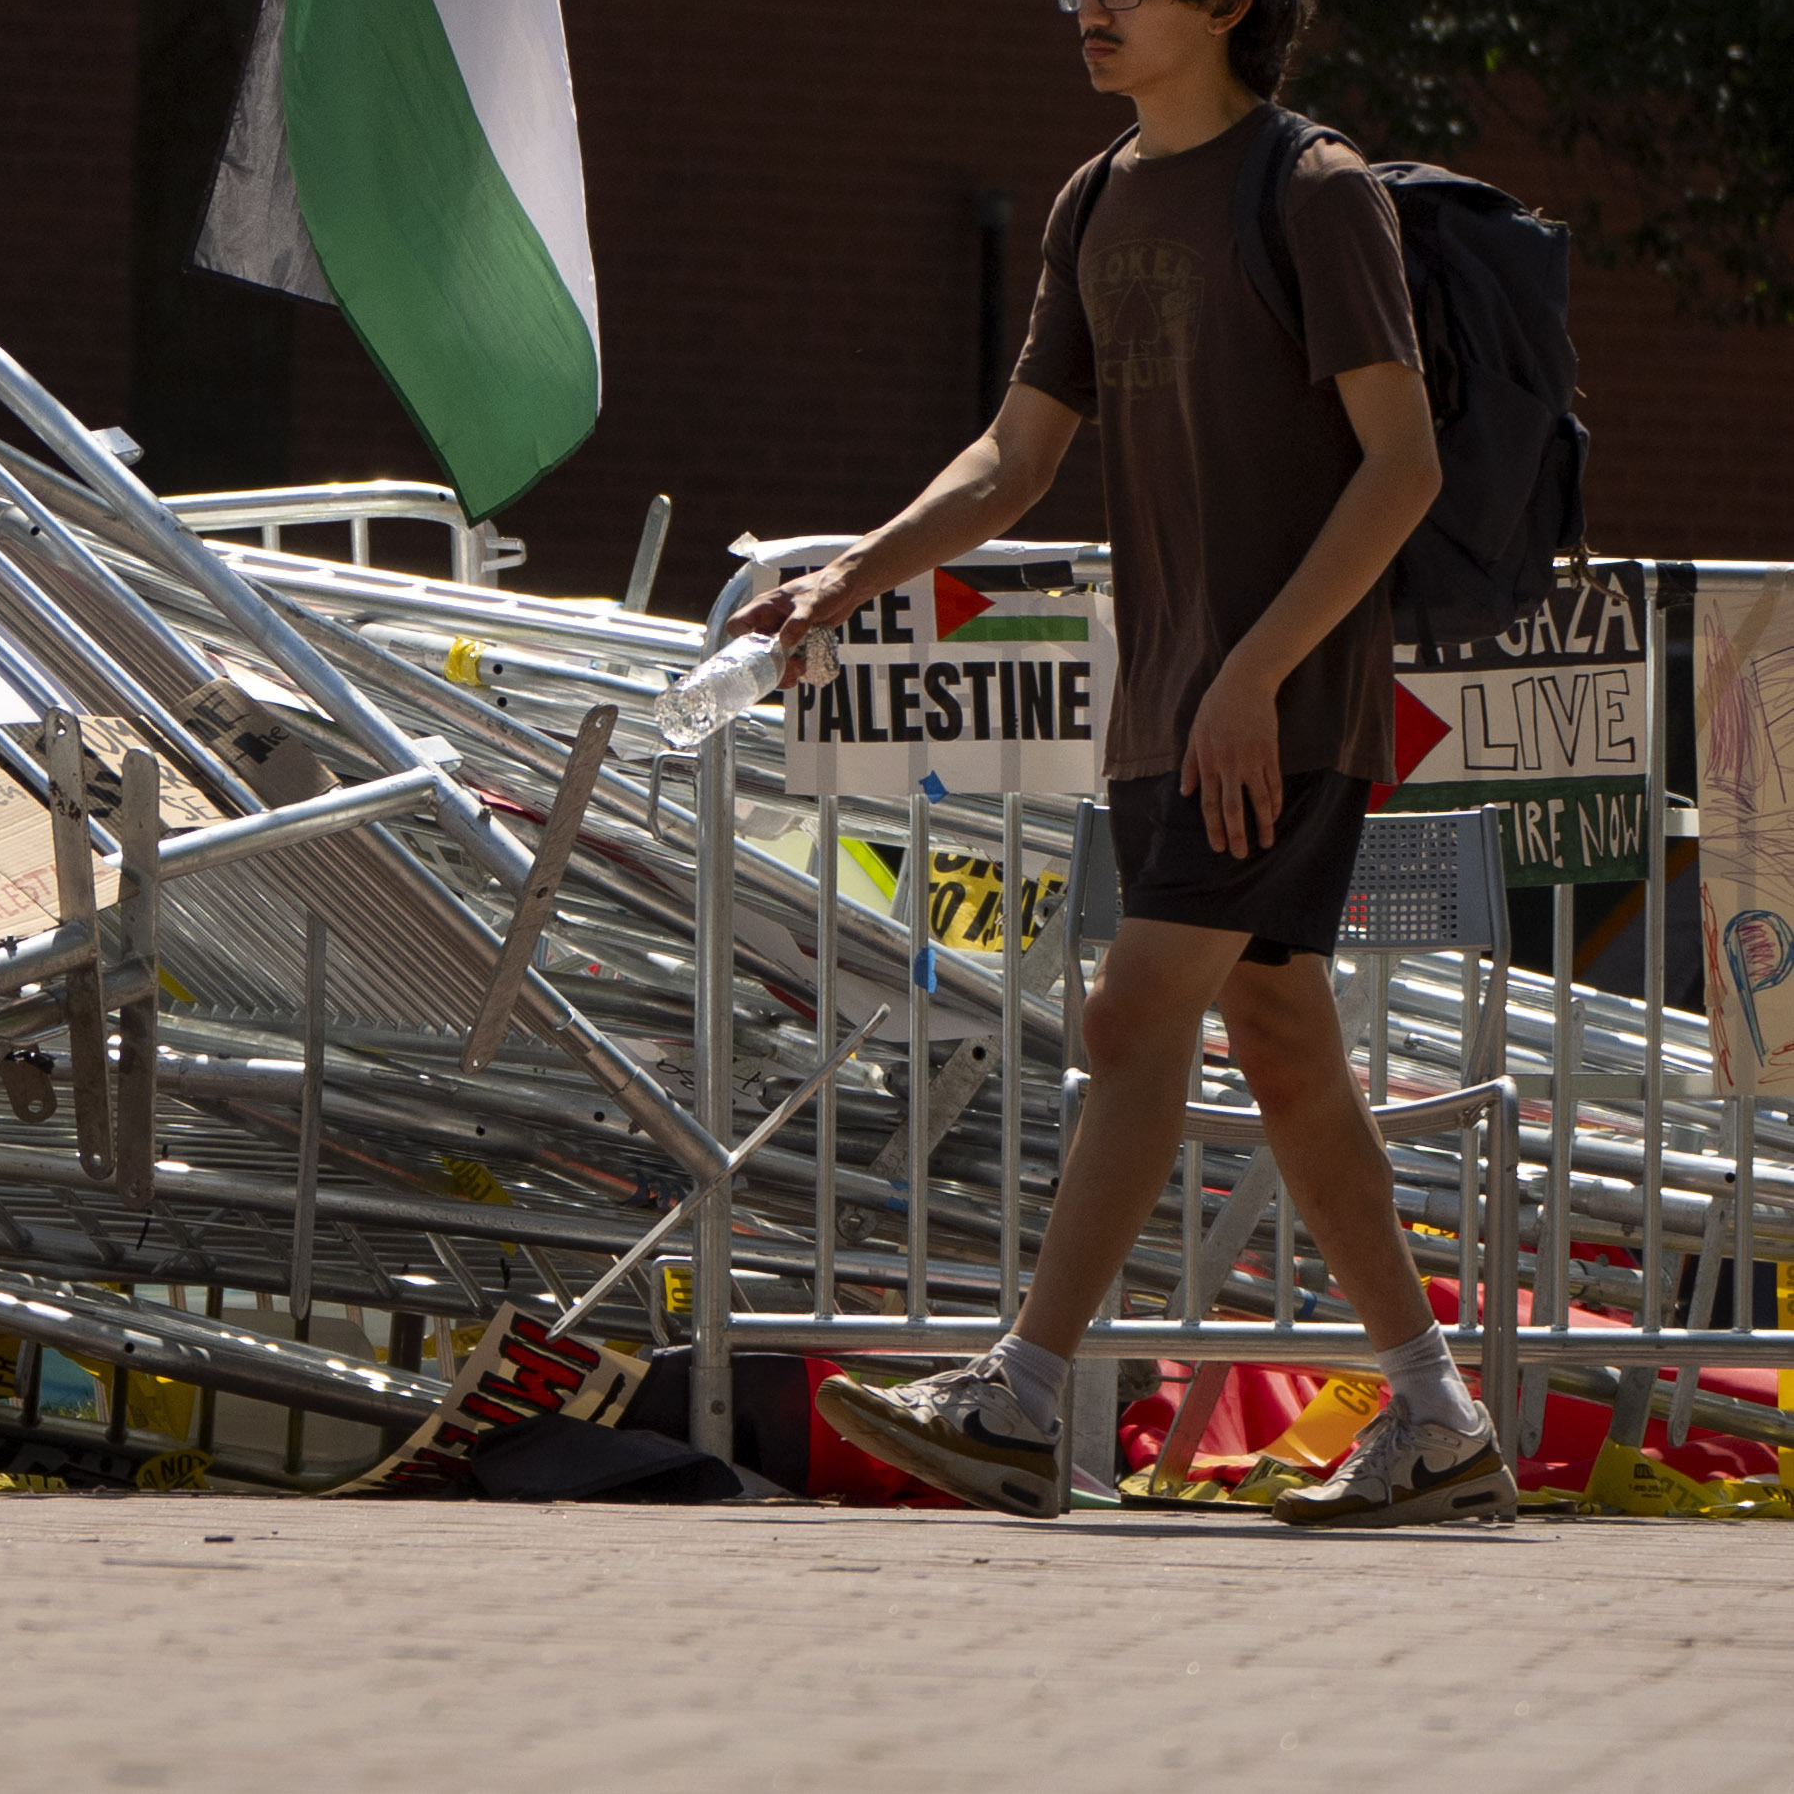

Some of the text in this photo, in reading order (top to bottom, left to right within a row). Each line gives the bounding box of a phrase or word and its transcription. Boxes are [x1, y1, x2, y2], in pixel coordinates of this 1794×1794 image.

[798, 661, 1093, 743] PALESTINE
[1460, 669, 1636, 772] LIVE
[1577, 793, 1643, 868] NOW
